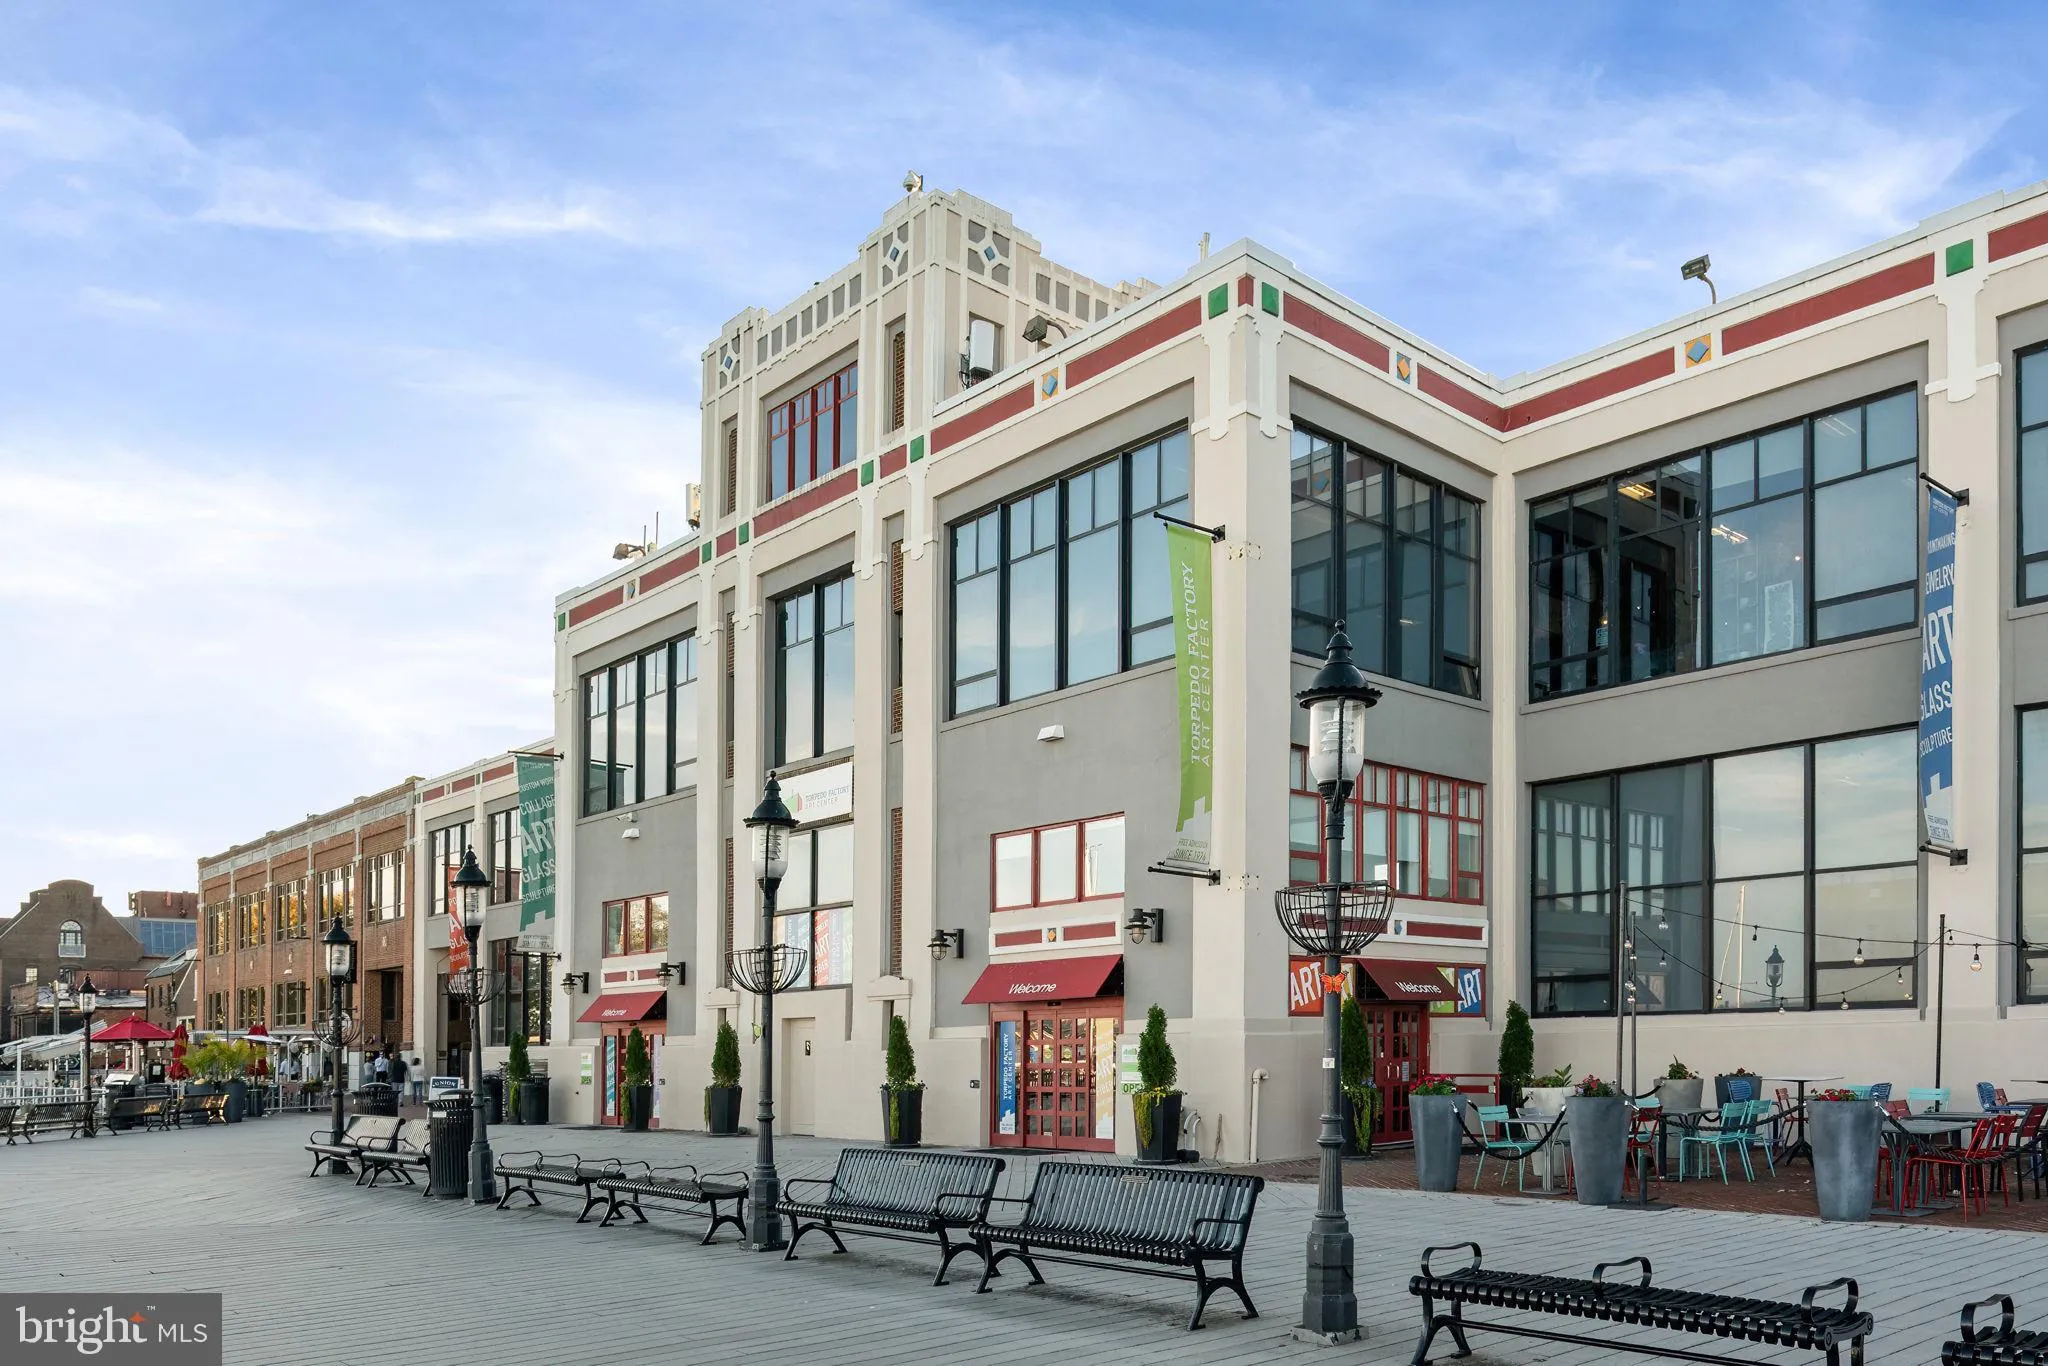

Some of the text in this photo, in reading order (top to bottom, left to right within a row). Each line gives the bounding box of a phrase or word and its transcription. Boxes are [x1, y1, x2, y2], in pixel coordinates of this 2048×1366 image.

[1925, 563, 1955, 595] EWELRY
[1922, 606, 1953, 674] ART
[1181, 560, 1201, 764] TORPEDO FACTORY
[1200, 619, 1211, 767] ART CENTER
[520, 816, 555, 857] ART
[521, 858, 556, 883] GLASS
[1008, 983, 1057, 994] Welcome
[1290, 962, 1322, 1011] ART
[1395, 981, 1442, 994] Welcome
[1457, 969, 1481, 1013] ART
